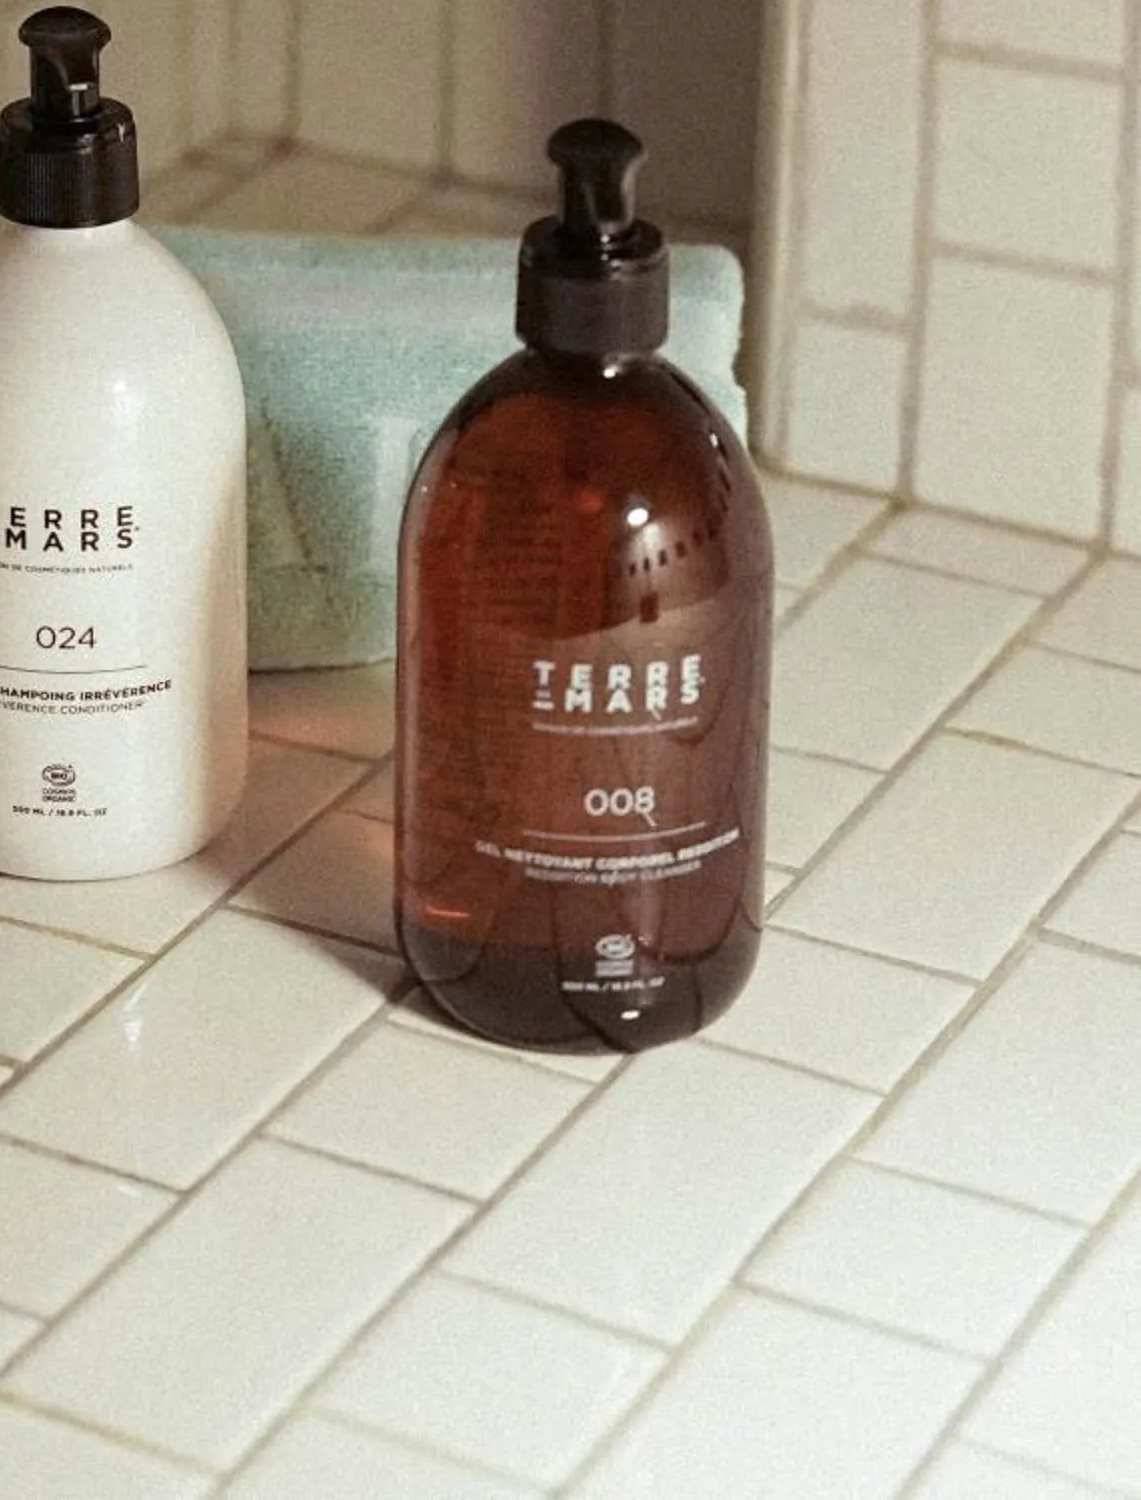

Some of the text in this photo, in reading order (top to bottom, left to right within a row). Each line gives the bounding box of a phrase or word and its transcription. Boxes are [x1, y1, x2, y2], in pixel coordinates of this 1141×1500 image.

[5, 528, 134, 552] MARS
[36, 626, 97, 649] 024
[532, 654, 702, 690] TERRE
[563, 684, 702, 714] MARS
[584, 786, 656, 817] 008
